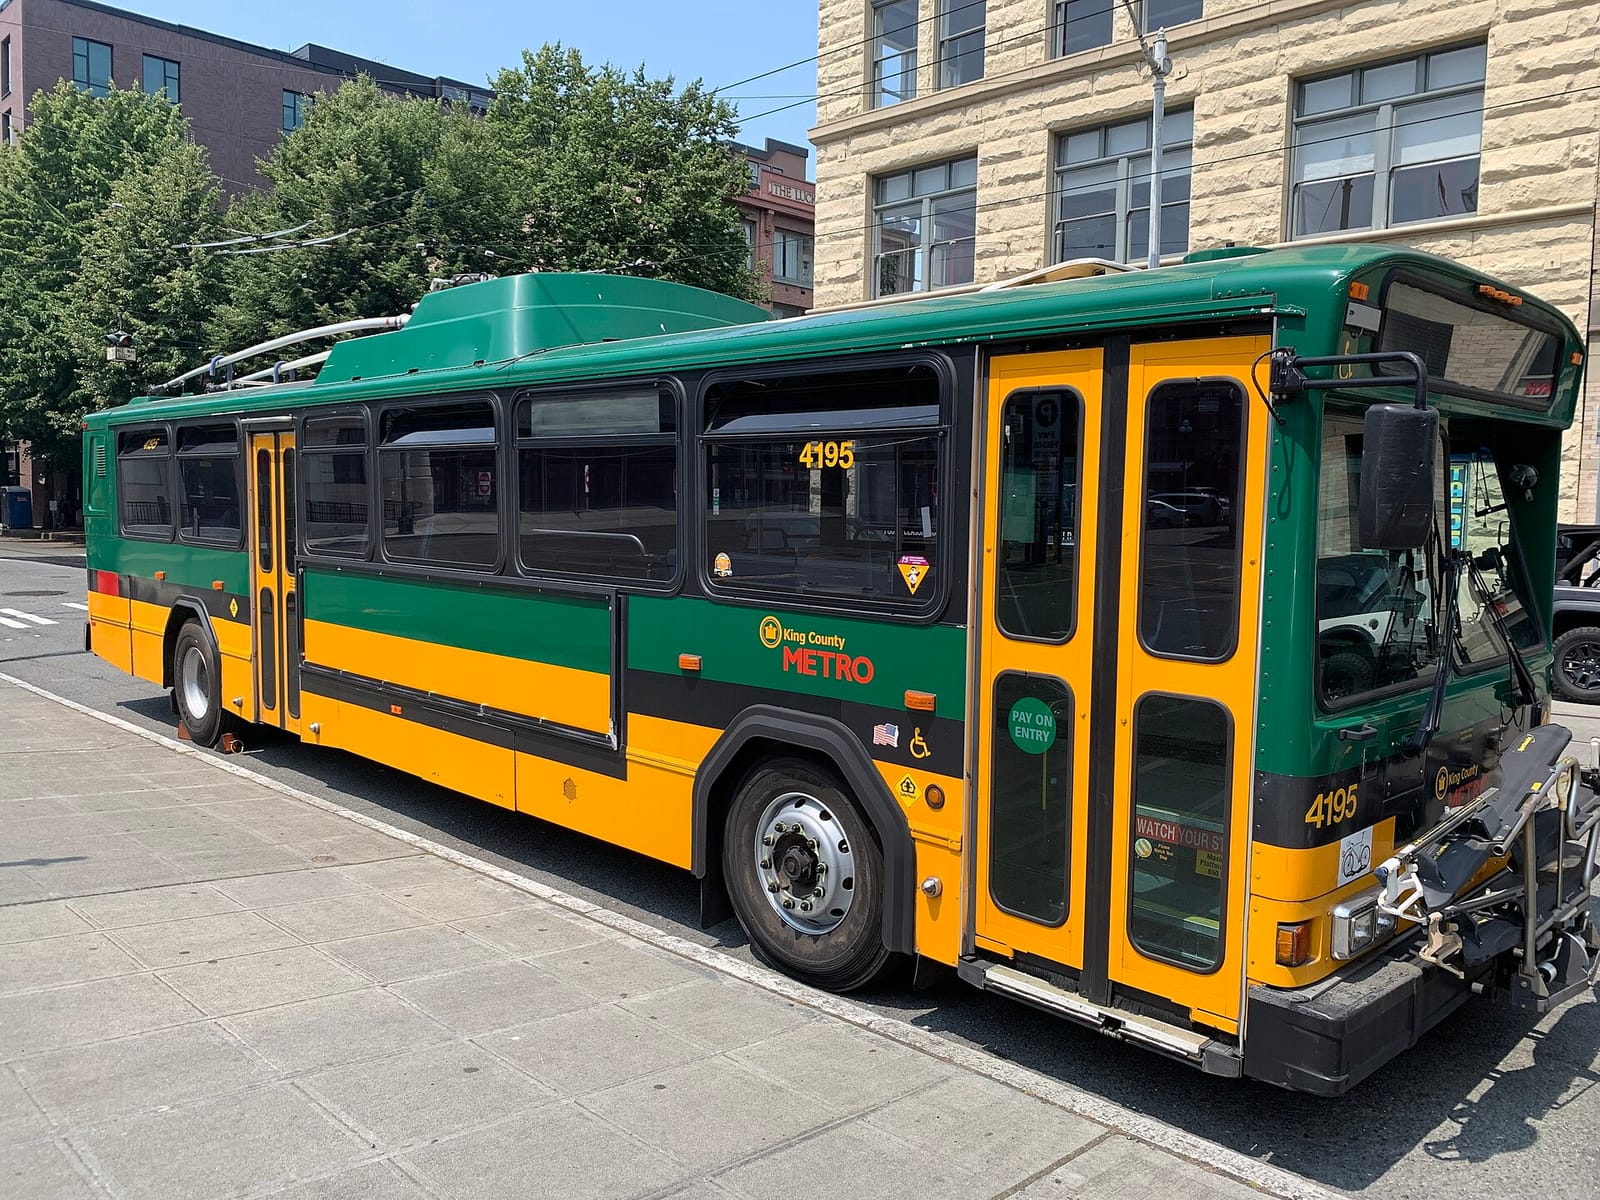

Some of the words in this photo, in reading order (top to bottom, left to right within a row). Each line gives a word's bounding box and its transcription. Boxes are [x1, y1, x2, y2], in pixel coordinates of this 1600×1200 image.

[771, 183, 792, 198] THE
[799, 441, 854, 469] 4195
[783, 628, 806, 645] King
[808, 631, 846, 650] County
[783, 645, 875, 684] METRO
[1012, 710, 1032, 723] PAY
[1035, 714, 1053, 727] ON
[1015, 726, 1050, 742] ENTRY
[1305, 783, 1358, 829] 4195
[1136, 818, 1175, 841] WATCH
[1179, 827, 1209, 849] YOUR
